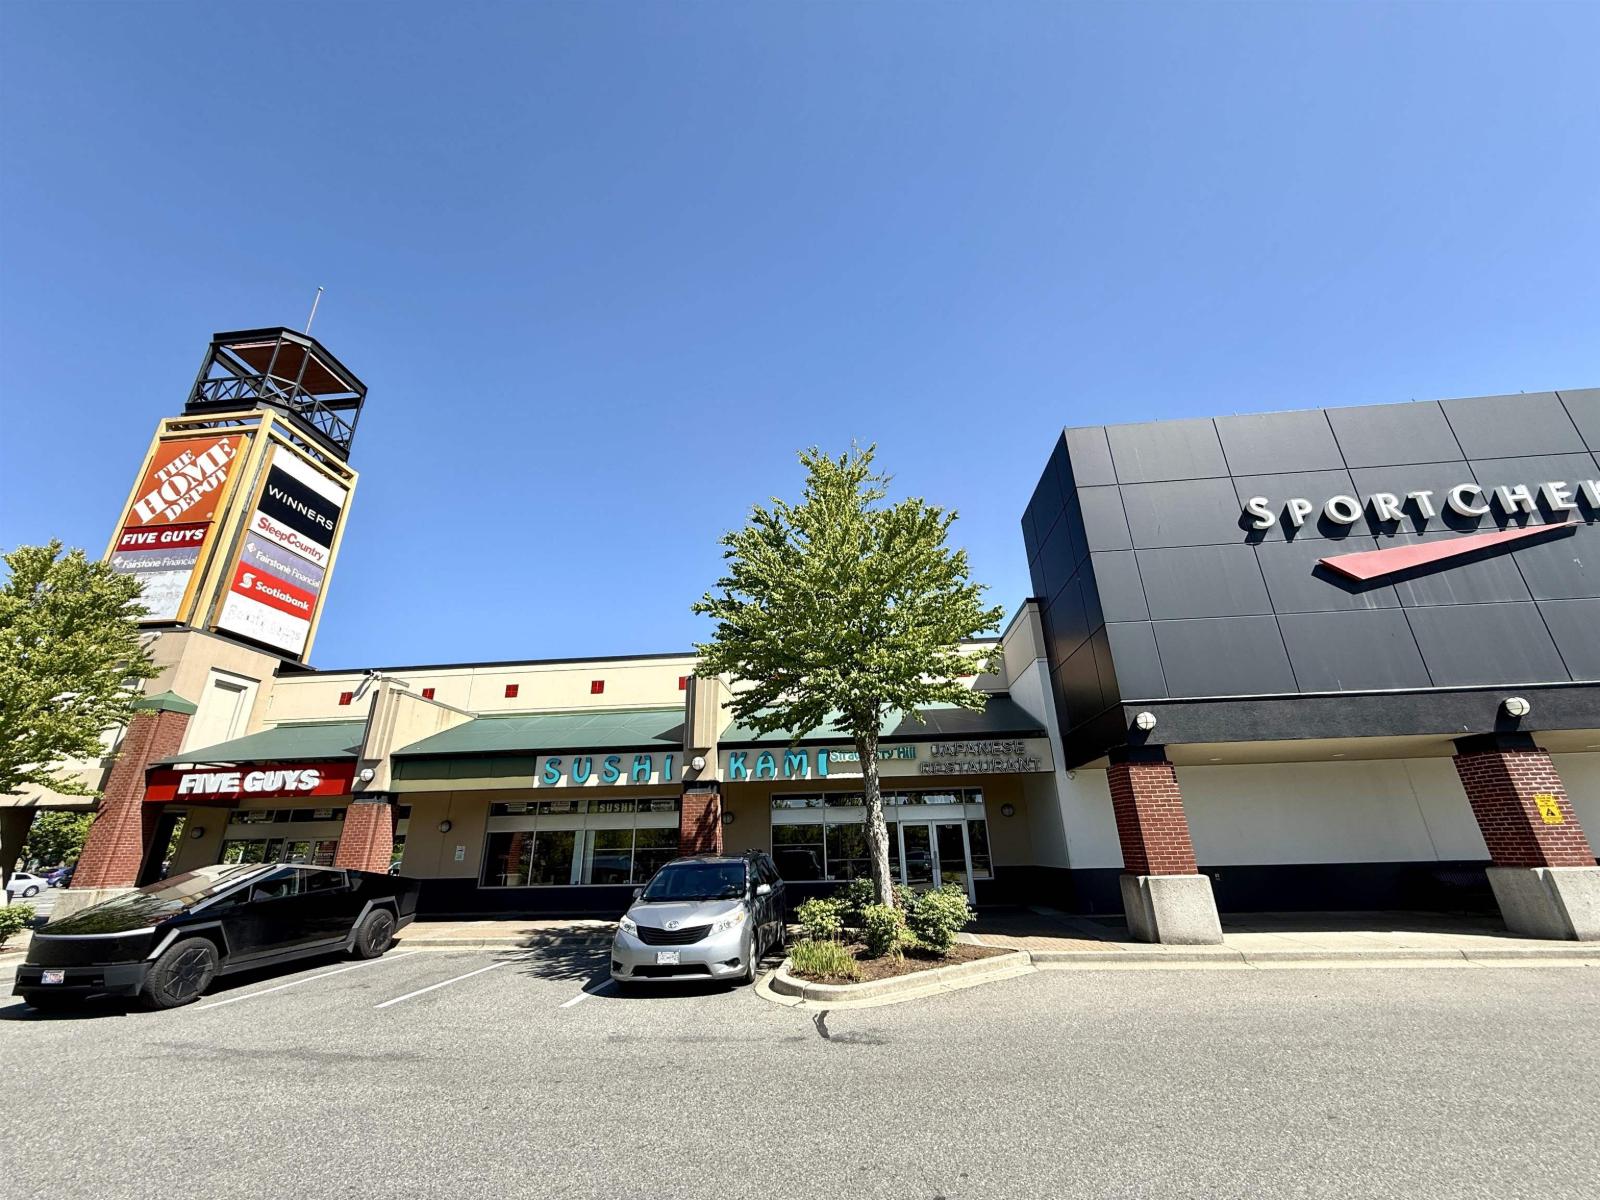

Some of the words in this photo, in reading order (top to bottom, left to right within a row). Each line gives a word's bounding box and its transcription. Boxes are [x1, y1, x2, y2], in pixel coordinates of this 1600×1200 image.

[133, 437, 237, 524] HOME
[153, 449, 196, 483] THE
[163, 466, 227, 522] DEPOT
[268, 484, 334, 531] WINNERS
[121, 532, 158, 545] FIVE
[160, 528, 205, 543] GUYS
[122, 559, 161, 569] Fairstone
[161, 553, 198, 567] Financial
[255, 550, 292, 574] Fairstone
[291, 567, 321, 588] Financial
[255, 581, 309, 611] Scotiabank
[829, 747, 894, 762] Strarry
[896, 746, 916, 760] Hill
[930, 740, 1025, 757] JAPANESE
[543, 754, 673, 785] SUSHI
[729, 748, 829, 780] KAMI
[919, 757, 1041, 774] RESTAURANT
[177, 772, 241, 794] FIVE
[243, 769, 321, 792] GUYS
